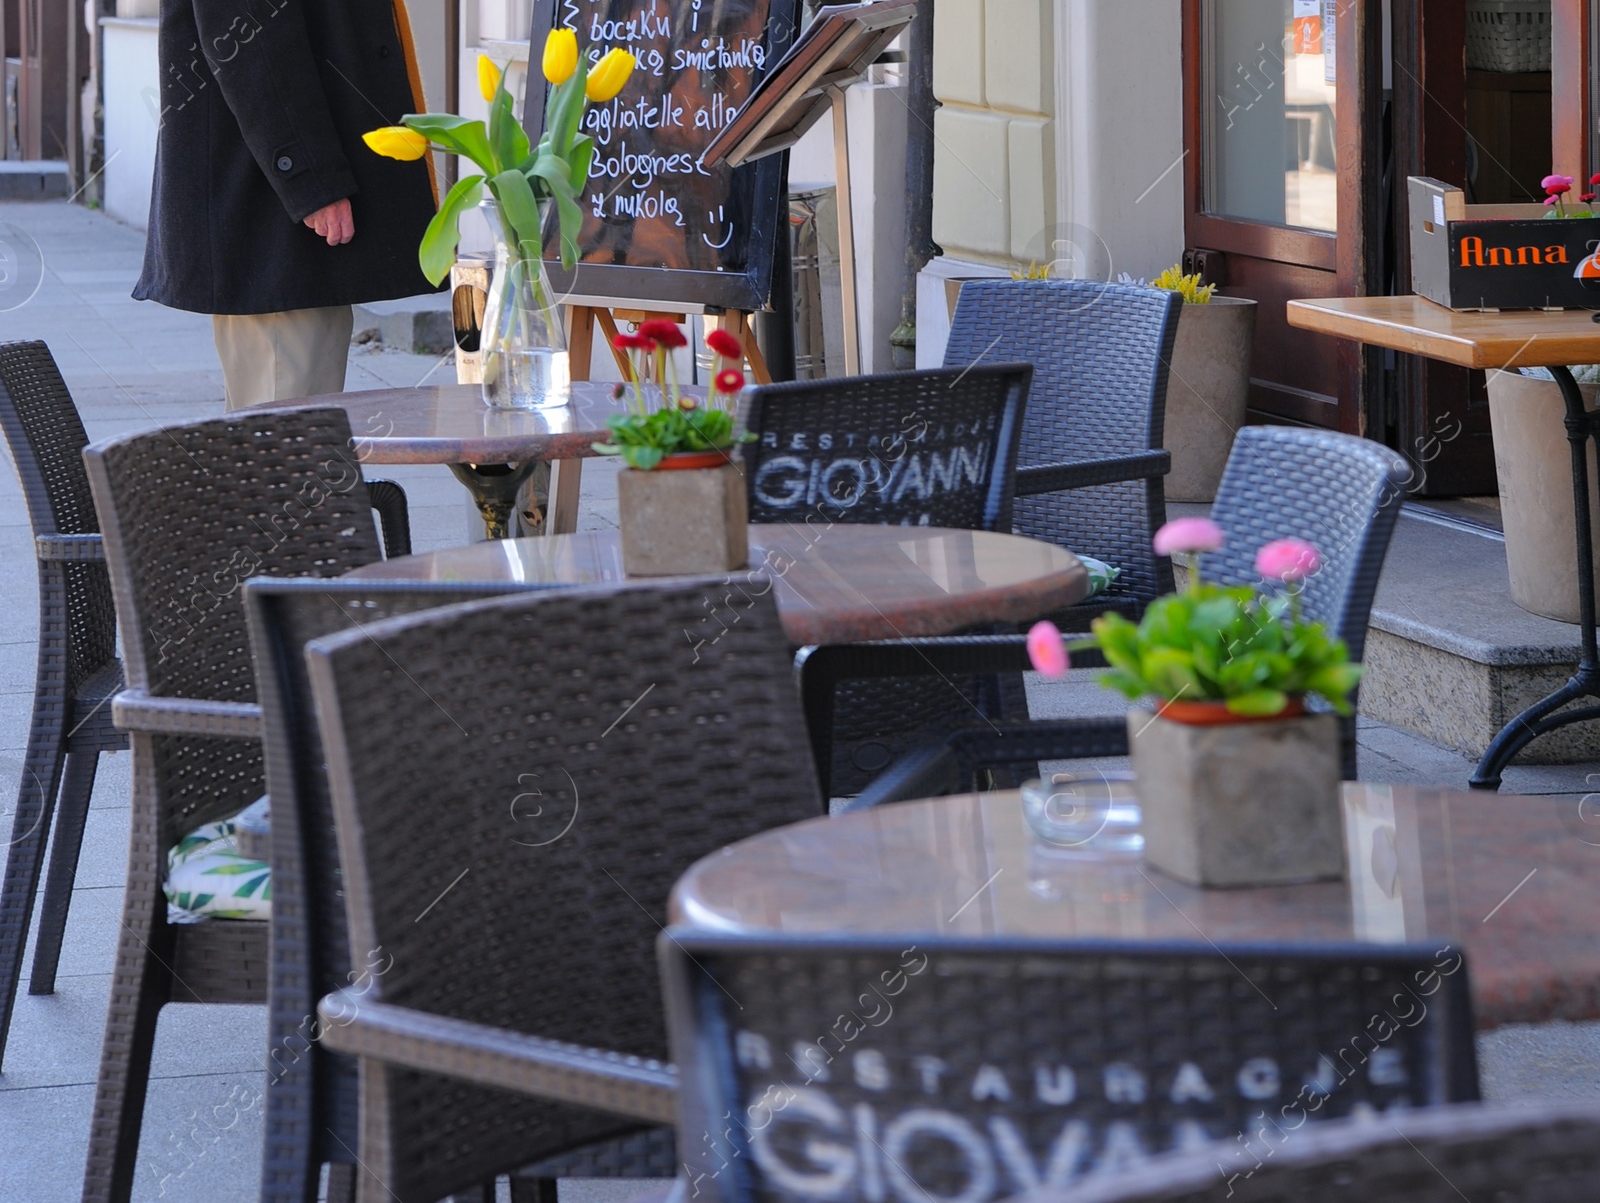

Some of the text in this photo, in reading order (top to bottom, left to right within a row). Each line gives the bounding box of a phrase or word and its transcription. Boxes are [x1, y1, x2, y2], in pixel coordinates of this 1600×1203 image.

[590, 10, 671, 42] boczku
[1459, 236, 1571, 268] Anna
[754, 441, 994, 510] GIOVANNI
